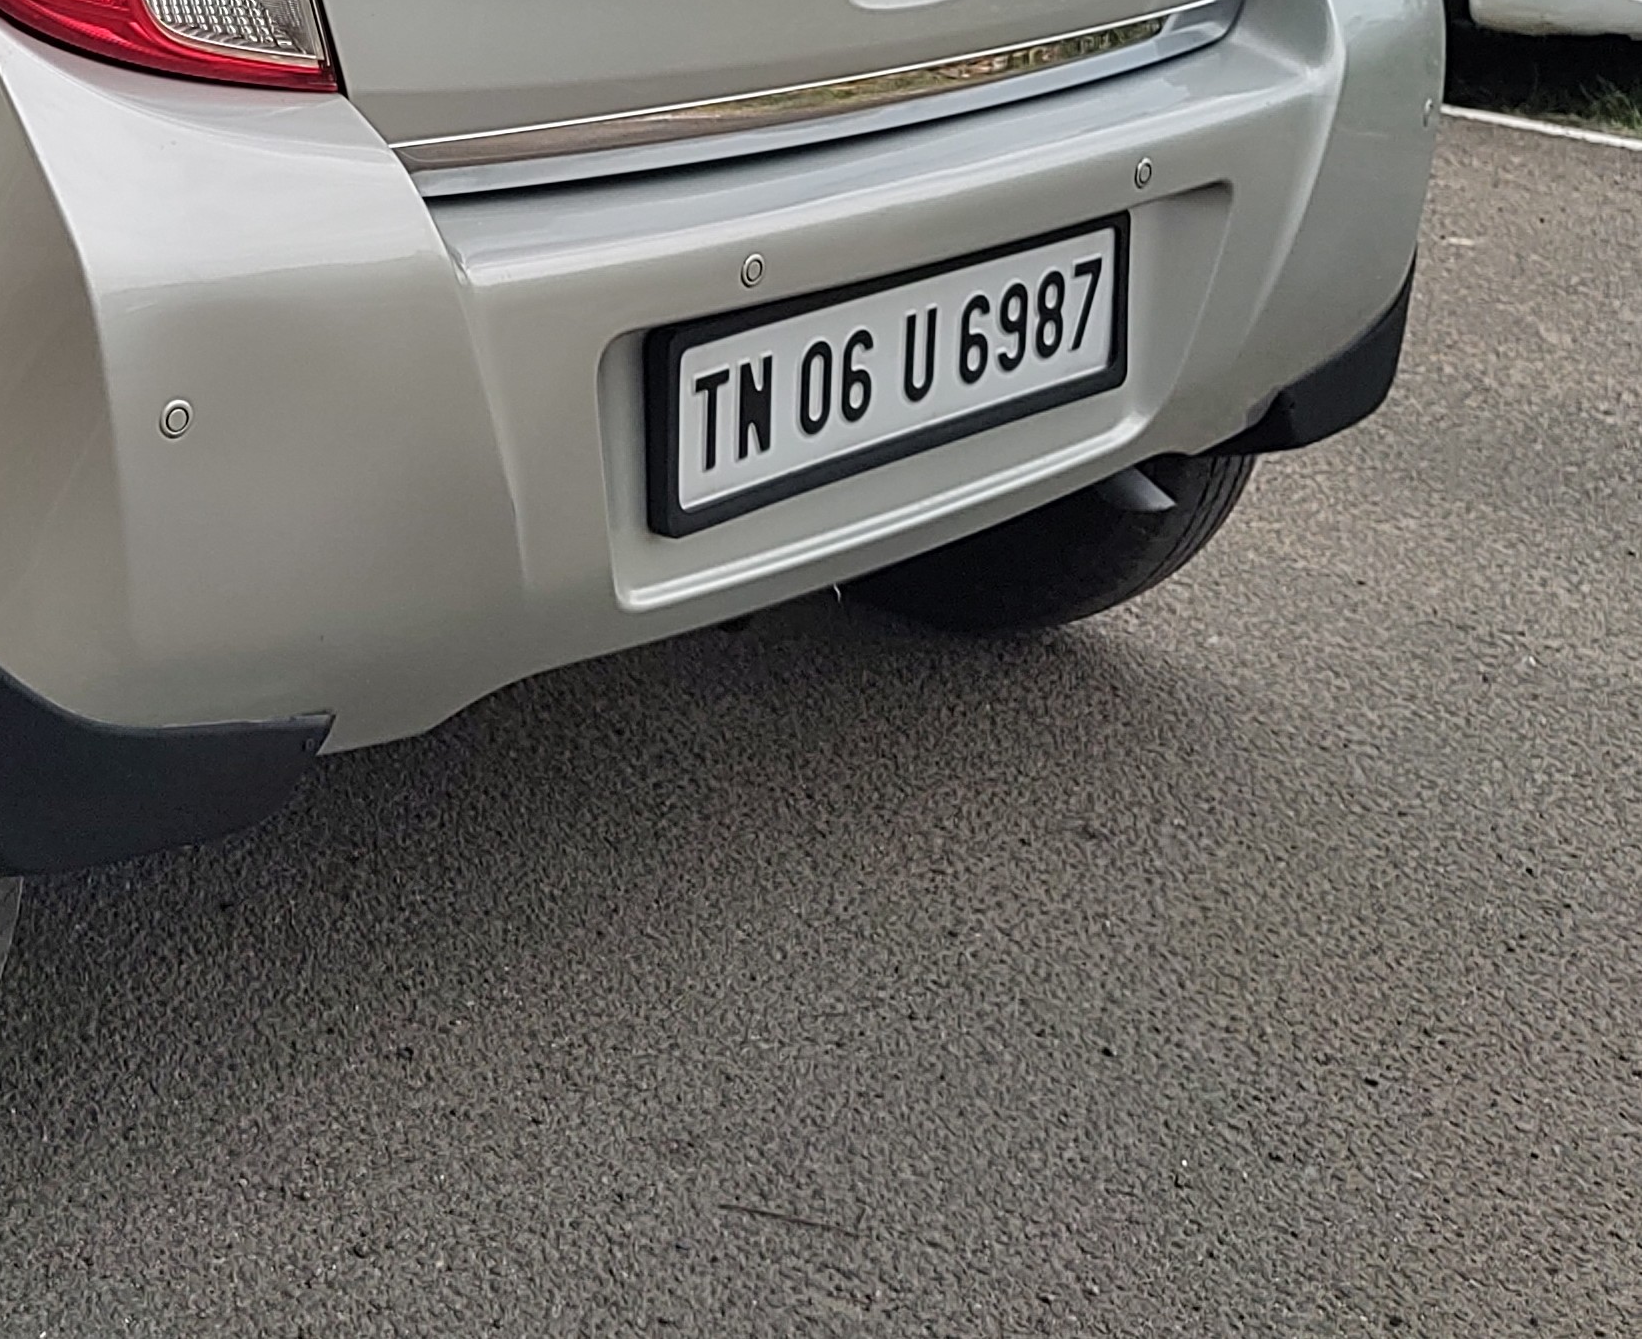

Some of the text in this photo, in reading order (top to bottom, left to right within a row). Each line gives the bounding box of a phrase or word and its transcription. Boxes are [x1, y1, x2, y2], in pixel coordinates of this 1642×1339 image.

[695, 257, 1102, 471] TN 06 U 6987
